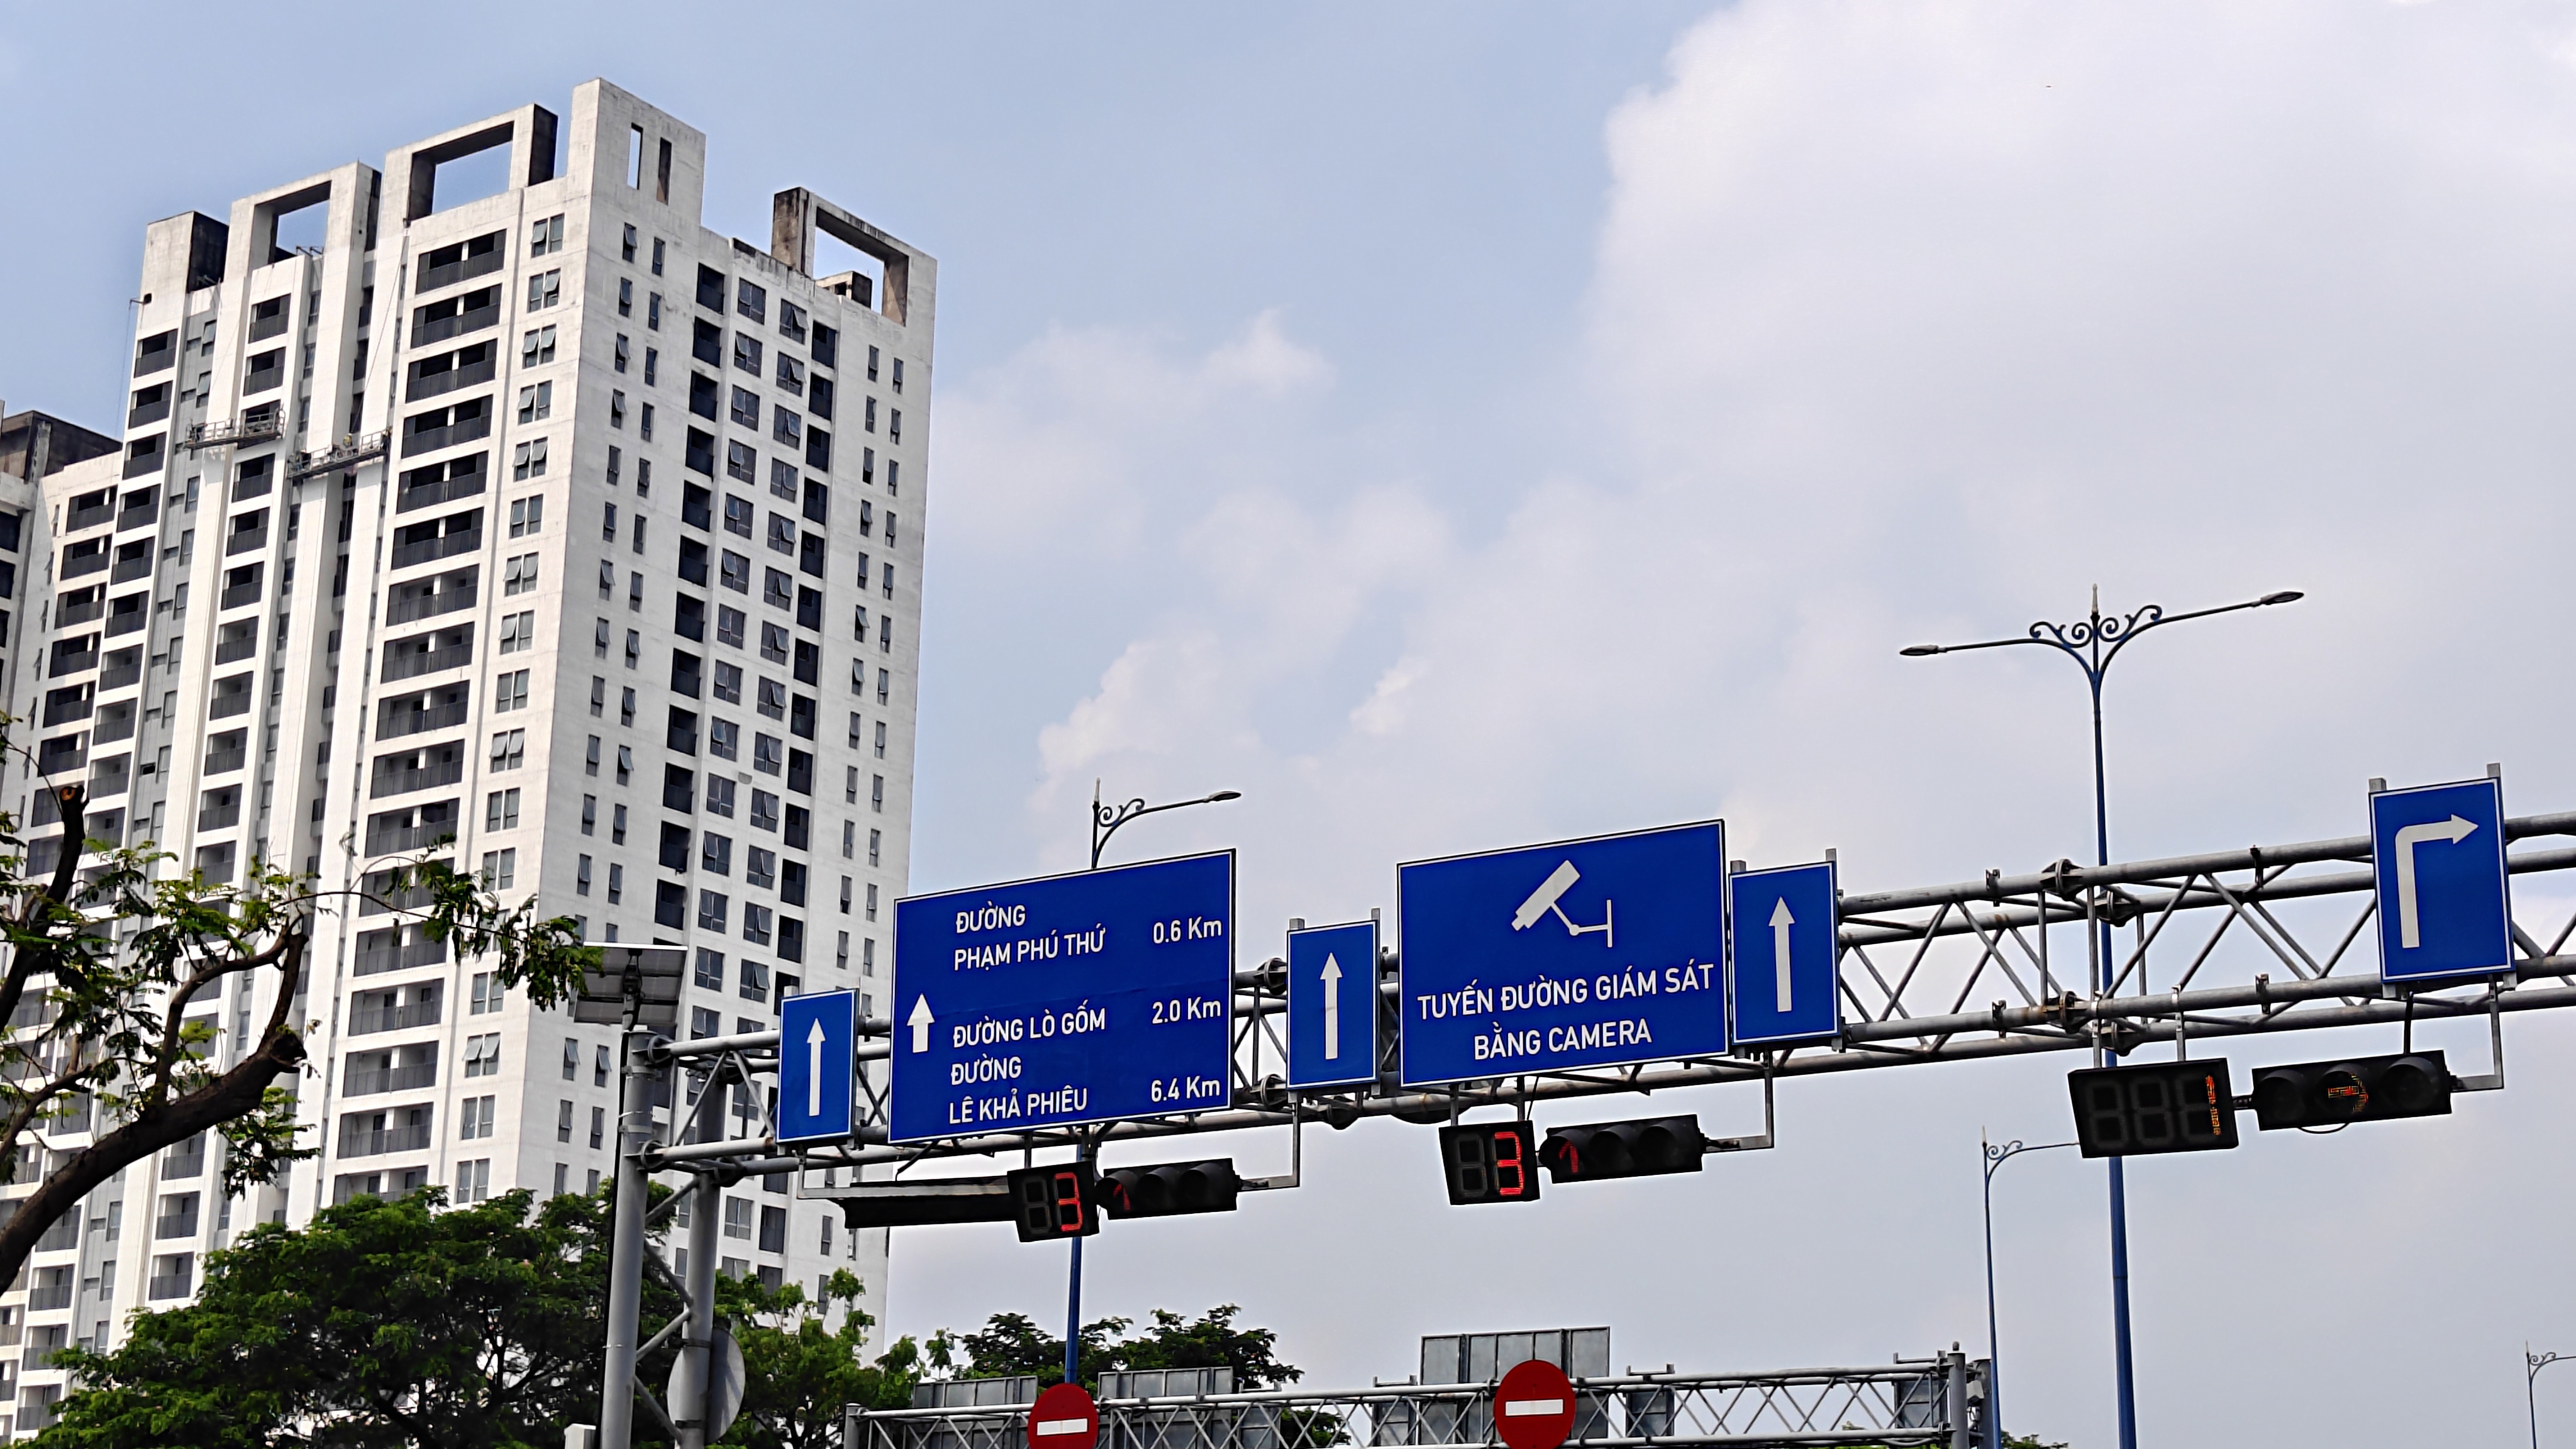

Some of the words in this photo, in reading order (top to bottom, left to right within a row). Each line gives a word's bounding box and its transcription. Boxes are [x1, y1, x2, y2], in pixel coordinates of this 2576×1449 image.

[955, 901, 1026, 933] ĐƯỜNG
[1153, 919, 1181, 944] 0.6
[1188, 916, 1222, 940] Km
[954, 943, 1011, 971] PHẠM
[1017, 929, 1058, 962] PHÚ
[1063, 923, 1106, 956] THỨ
[1417, 979, 1493, 1020] TUYẾN
[1501, 975, 1587, 1011] ĐƯỜNG
[1596, 965, 1657, 1001] GIÁM
[1665, 958, 1714, 993] SÁT
[953, 1015, 1023, 1048] ĐƯỜNG
[1030, 1009, 1055, 1039] LÒ
[1062, 999, 1105, 1035] GỐM
[1152, 999, 1180, 1024] 2.0
[1187, 996, 1221, 1020] Km
[1474, 1021, 1541, 1060] BẰNG
[1548, 1018, 1652, 1052] CAMERA
[950, 1053, 1021, 1085] ĐƯỜNG
[1151, 1078, 1180, 1102] 6.4
[1186, 1075, 1220, 1099] Km
[949, 1096, 974, 1124] LÊ
[979, 1088, 1021, 1122] KHẢ
[1027, 1084, 1087, 1116] PHIÊU
[1494, 1131, 1525, 1196] 3
[1054, 1172, 1084, 1232] 3
